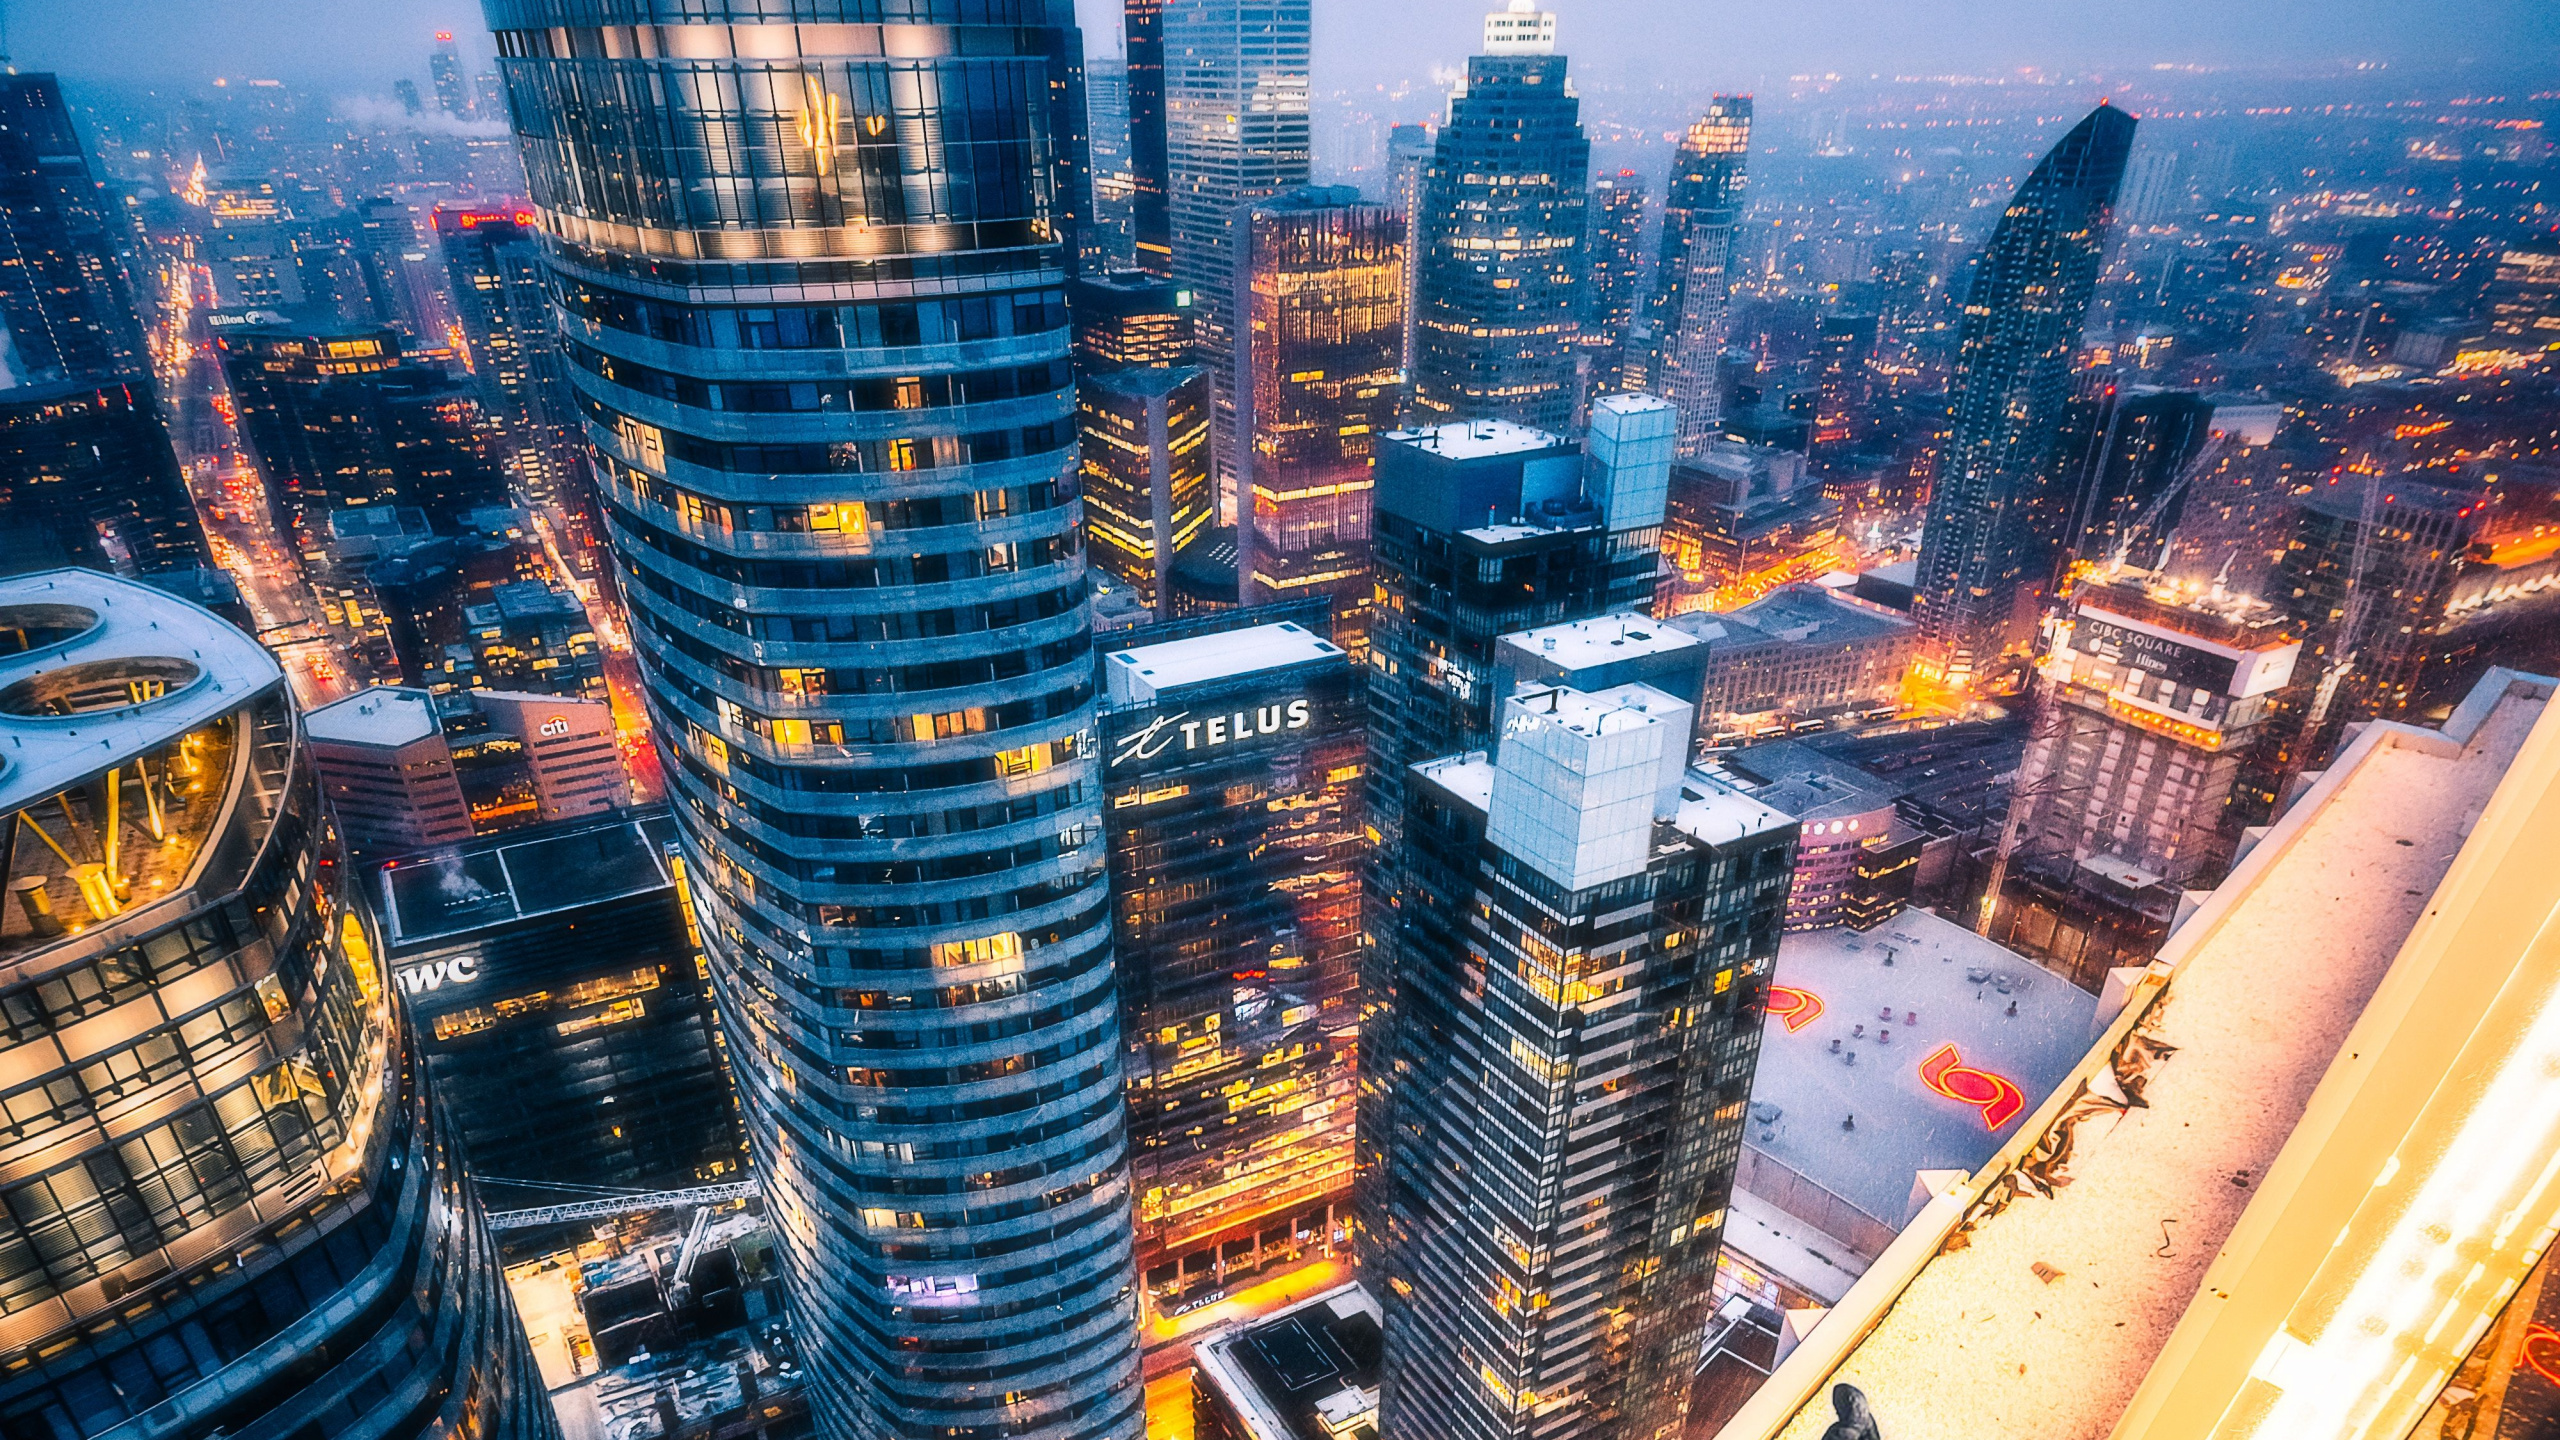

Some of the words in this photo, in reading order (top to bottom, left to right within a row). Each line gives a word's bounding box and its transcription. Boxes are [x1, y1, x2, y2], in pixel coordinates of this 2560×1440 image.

[208, 314, 246, 326] Hilton
[2089, 621, 2123, 640] CIBC
[2126, 632, 2182, 659] SQUARE
[1179, 699, 1310, 750] TELUS
